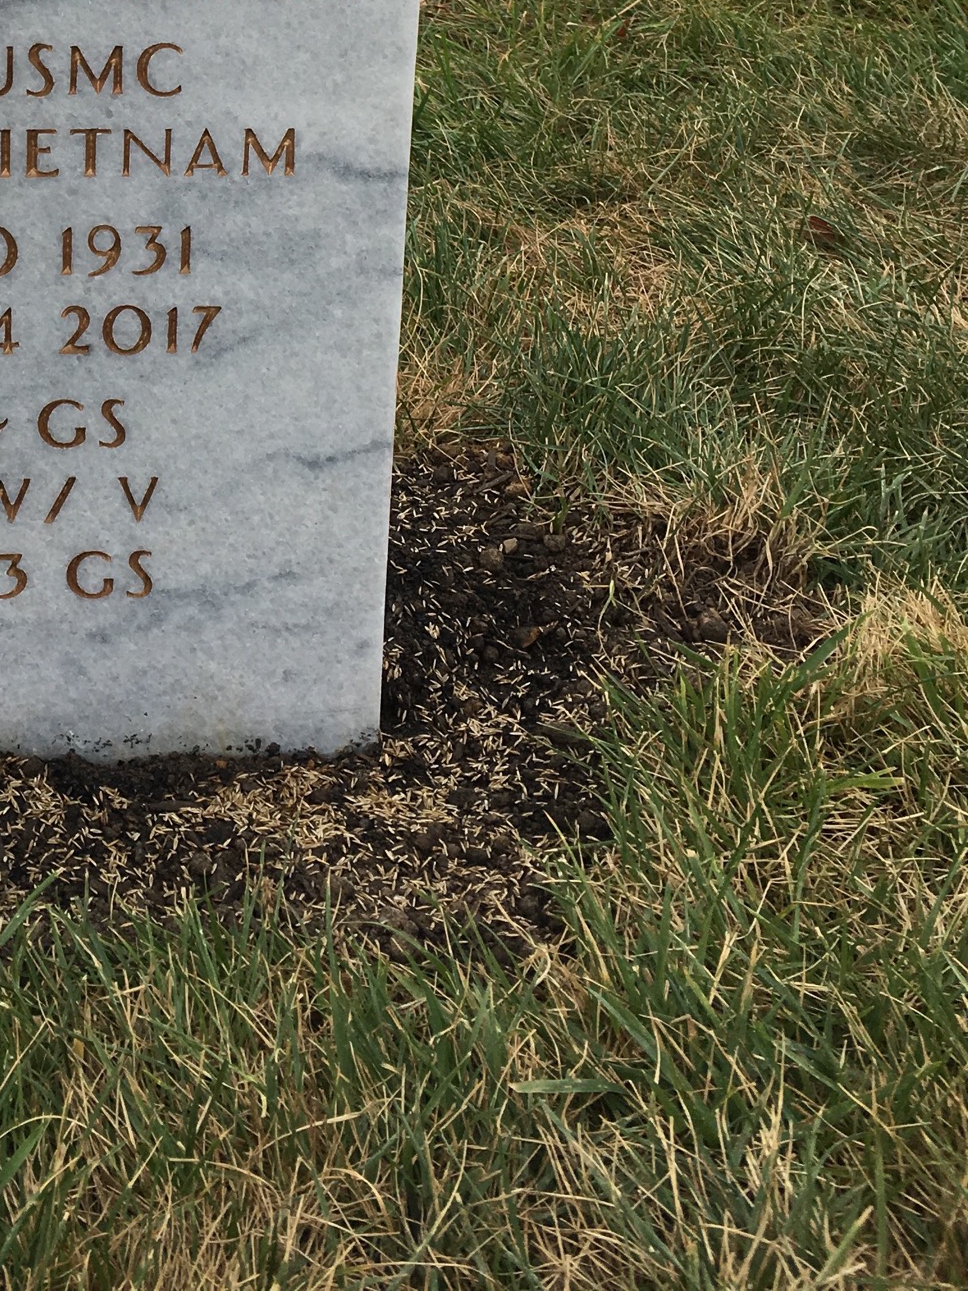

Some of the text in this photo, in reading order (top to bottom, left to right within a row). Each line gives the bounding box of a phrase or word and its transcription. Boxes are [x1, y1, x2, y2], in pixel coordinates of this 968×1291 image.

[60, 224, 191, 277] 1931
[59, 304, 222, 356] 2017
[37, 398, 126, 449] GS
[66, 549, 153, 599] GS
